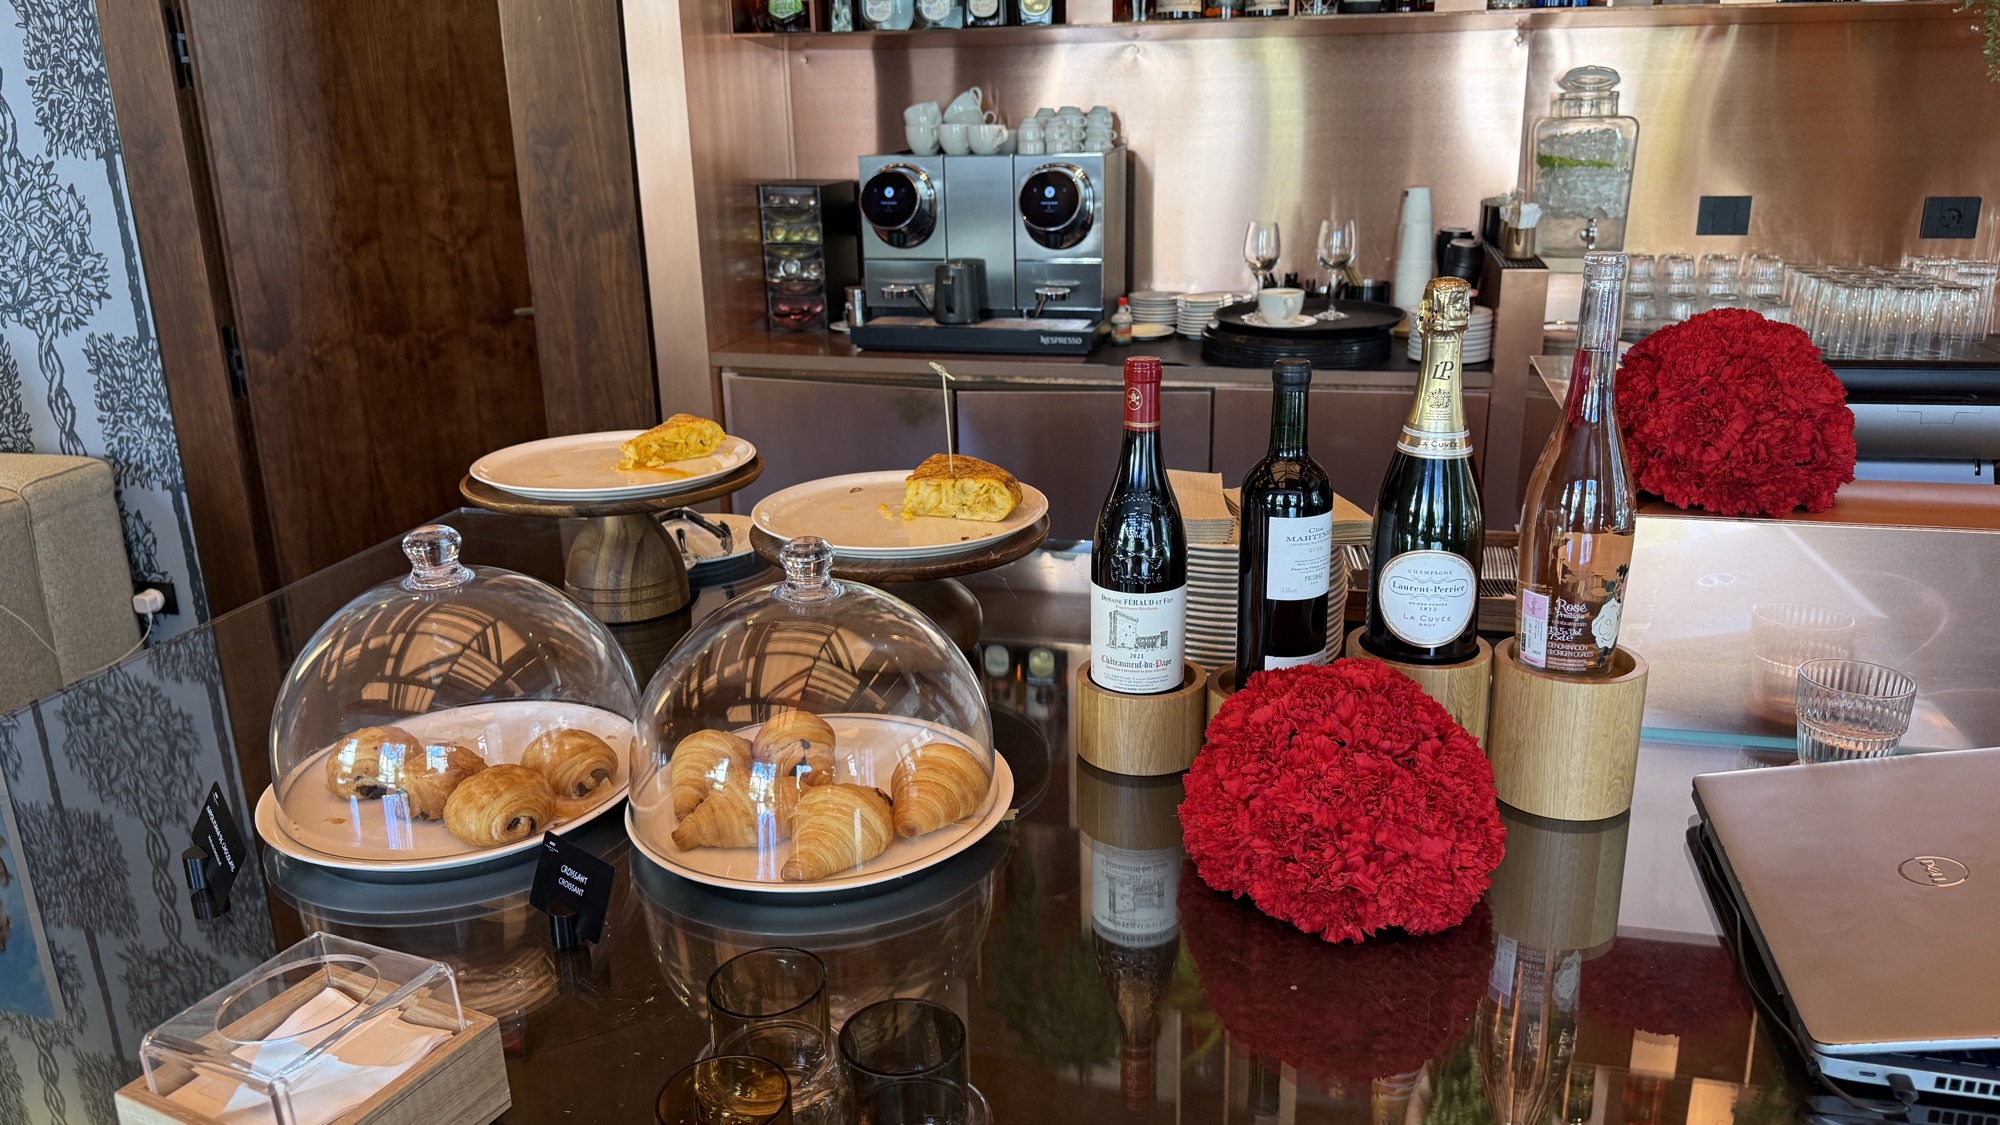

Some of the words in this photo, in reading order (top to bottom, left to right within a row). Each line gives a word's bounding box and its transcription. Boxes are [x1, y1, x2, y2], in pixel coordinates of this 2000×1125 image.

[1040, 335, 1082, 345] NESPRESSO
[1393, 581, 1464, 593] Laurent-Perrier
[1124, 598, 1154, 606] FÉRAUD
[1555, 596, 1587, 613] Rosé
[1420, 614, 1451, 622] CUVÉE
[560, 864, 588, 885] CROISSANT
[1919, 859, 1947, 883] DELL
[558, 877, 584, 897] CROISSANT
